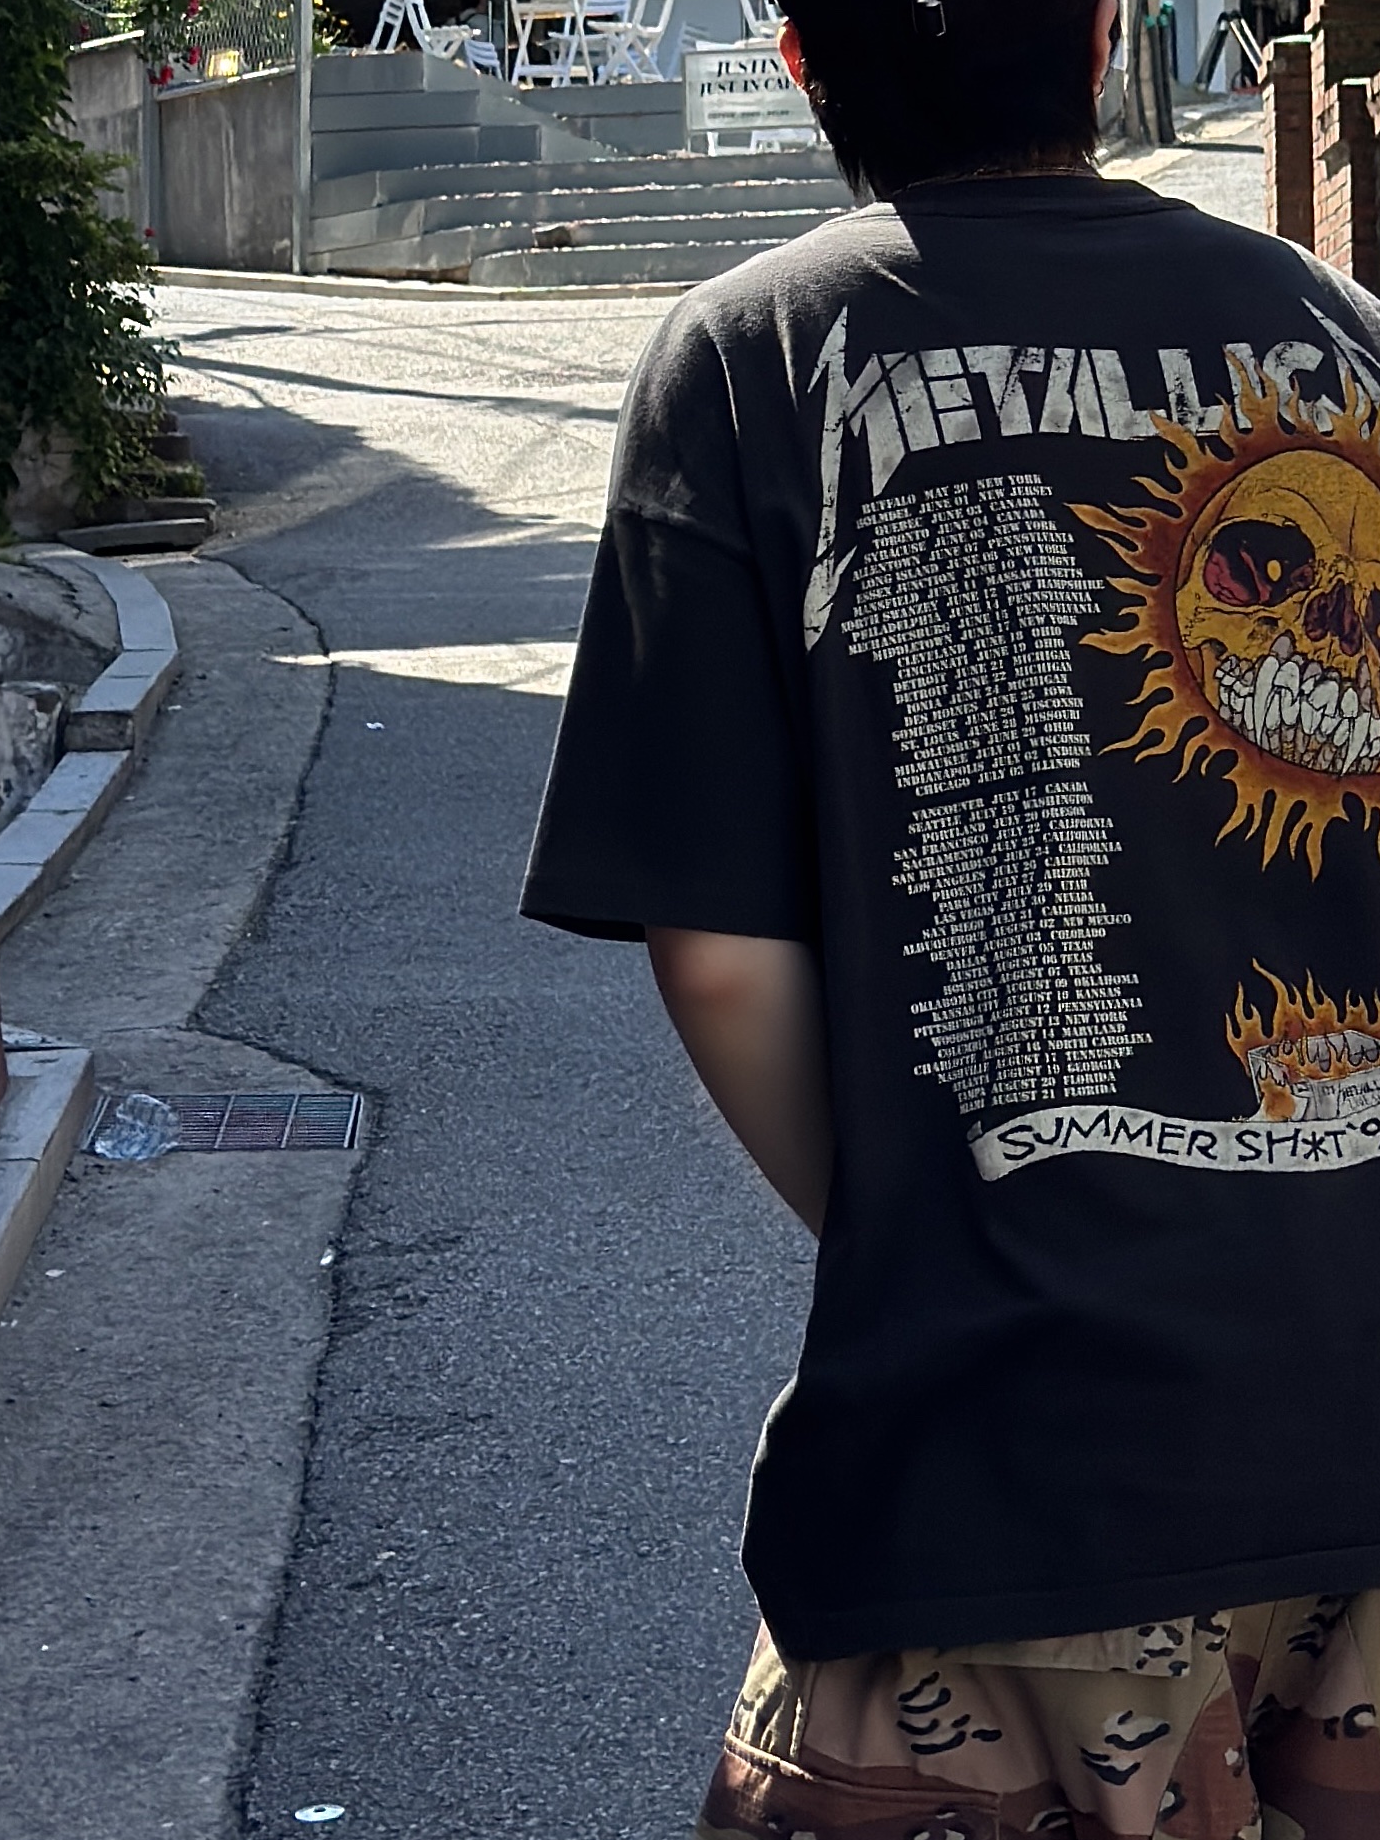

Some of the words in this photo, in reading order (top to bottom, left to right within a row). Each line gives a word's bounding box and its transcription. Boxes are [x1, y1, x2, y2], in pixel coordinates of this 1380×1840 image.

[700, 80, 736, 97] JUST
[743, 79, 761, 92] IN
[860, 494, 917, 513] BUFFALO
[923, 486, 948, 499] MAY
[975, 476, 1003, 488] NEW
[1008, 473, 1042, 484] YORK
[871, 528, 930, 548] TORONTO
[936, 519, 970, 534] JUNE
[995, 508, 1046, 522] CANADA
[873, 517, 922, 535] QUEBEC
[930, 508, 964, 523] JUNE
[988, 497, 1040, 511] CANADA
[852, 554, 921, 579] ALLENTOWN
[929, 546, 960, 560] JUNE
[986, 532, 1075, 548] PENNSYLVANIA
[862, 541, 927, 563] SYRACUSE
[933, 532, 967, 546] JUNE
[992, 522, 1020, 535] NEW
[1025, 520, 1057, 530] YORK
[926, 583, 960, 598] JUNE
[985, 567, 1084, 585] MASSACHUSETTS
[850, 612, 942, 641] PHILADELPHIA
[947, 602, 982, 617] JUNE
[1006, 591, 1092, 604] PENNSYLVANIA
[956, 613, 991, 628] JUNE
[1015, 602, 1101, 614] PENNSYLVANIA
[871, 633, 953, 660] MIDDLETOWN
[959, 624, 994, 640] JUNE
[1018, 614, 1045, 627] NEW
[1050, 614, 1079, 625] YORK
[896, 643, 966, 667] CLEVELAND
[972, 634, 1007, 649] JUNE
[1030, 625, 1063, 637] OHIO
[891, 672, 946, 692] DETROIT
[953, 663, 987, 678] JUNE
[1011, 649, 1071, 664] MICHIGAN
[896, 655, 969, 679] CINCINNATI
[975, 645, 1010, 660] JUNE
[1033, 637, 1065, 648] OHIO
[906, 698, 943, 713] IONIA
[950, 688, 982, 703] JUNE
[1006, 673, 1068, 690] MICHIGAN
[890, 719, 956, 740] SOMERSET
[963, 709, 998, 725] JUNE
[1020, 697, 1084, 711] WISCONSIN
[893, 753, 969, 776] MILWAUKEE
[974, 745, 1003, 759] JULY
[1029, 733, 1091, 746] WISCONSIN
[912, 738, 981, 760] COLUMBUS
[986, 729, 1019, 744] JUNE
[1042, 721, 1075, 732] OHIO
[896, 761, 985, 787] INDIANAPOLIS
[990, 753, 1021, 767] JULY
[1045, 745, 1092, 756] INDIANA
[914, 777, 971, 796] CHICAGO
[976, 769, 1005, 783] JULY
[1030, 757, 1081, 771] ILLINOIS
[990, 790, 1020, 804] JULY
[1044, 781, 1089, 793] CANADA
[907, 814, 962, 833] SEATTLE
[968, 807, 996, 821] JULY
[1021, 793, 1094, 809] WASHINGTON
[892, 847, 918, 860] SAN
[921, 833, 989, 855] FRANCISCO
[995, 826, 1023, 839] JULY
[1047, 817, 1114, 829] CALIFORNIA
[901, 846, 984, 870] SACRAMENTO
[989, 839, 1017, 852] JULY
[1041, 829, 1108, 842] CALIFORNIA
[931, 882, 985, 901] PHOENIX
[990, 875, 1019, 888] JULY
[1042, 867, 1091, 879] ARIZONA
[933, 870, 986, 888] ANGELES
[991, 863, 1019, 876] JULY
[1043, 854, 1110, 866] CALIFORNIA
[929, 944, 976, 961] DENVER
[982, 934, 1022, 951] AUGUST
[1049, 927, 1107, 940] COLORADO
[993, 920, 1035, 936] AUGUST
[1062, 915, 1084, 927] NEW
[1086, 913, 1132, 925] MEXICO
[992, 944, 1034, 960] AUGUST
[1060, 940, 1094, 951] TEXAS
[909, 992, 975, 1013] OKLAHOMA
[975, 987, 999, 1000] CITY
[1006, 979, 1050, 993] AUGUST
[1073, 973, 1139, 986] OKLAHOMA
[998, 967, 1043, 983] AUGUST
[1066, 963, 1103, 975] TEXAS
[989, 1004, 1030, 1021] AUGUST
[1056, 997, 1143, 1012] PENNSYLVANIA
[997, 1108, 1218, 1162] SUMMER
